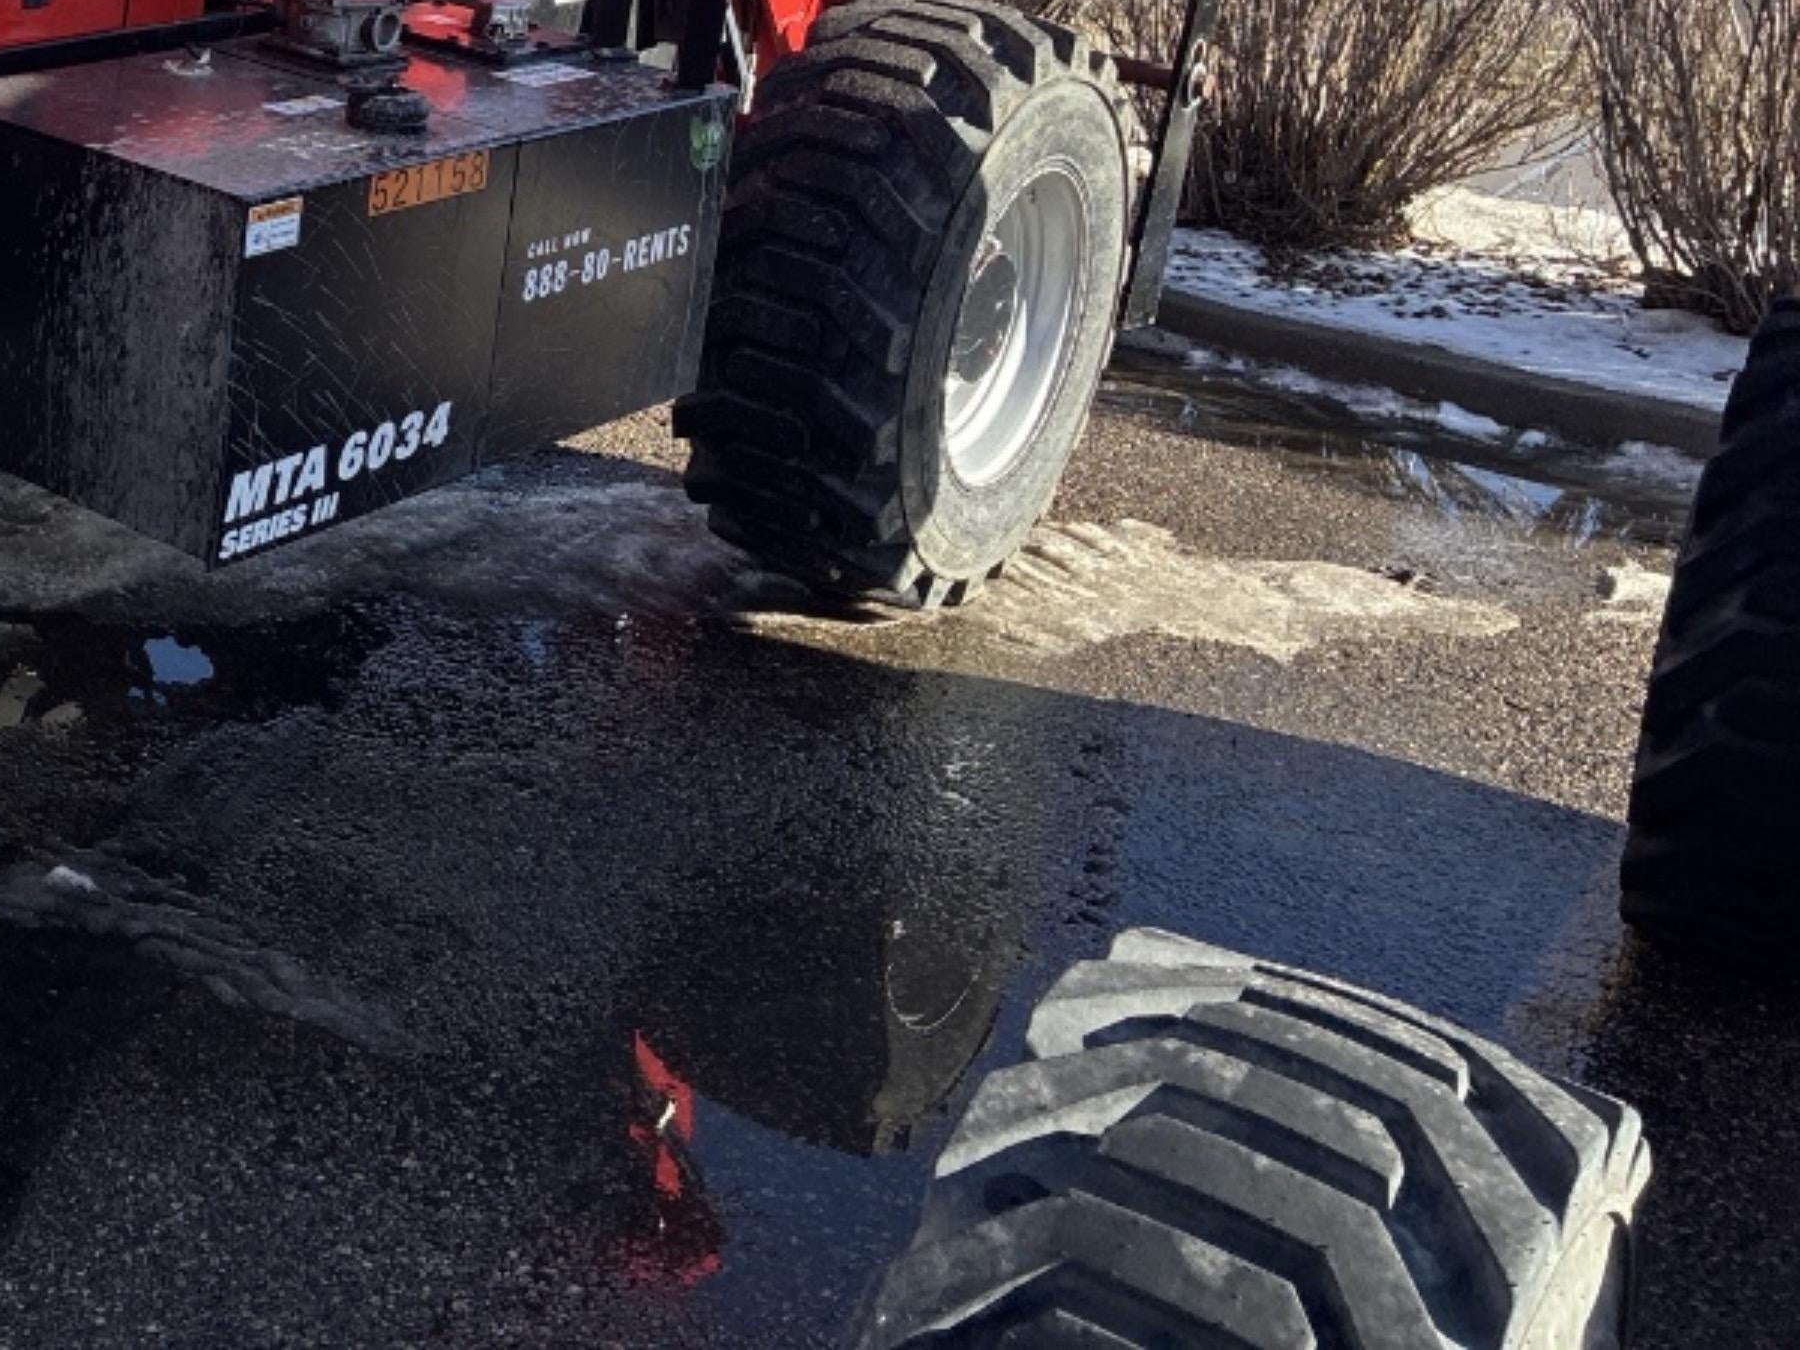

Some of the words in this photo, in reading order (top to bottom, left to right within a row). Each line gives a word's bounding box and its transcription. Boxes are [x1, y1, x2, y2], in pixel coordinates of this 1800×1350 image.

[522, 223, 693, 303] 888-80-RENTS
[527, 238, 559, 260] CALL
[563, 227, 593, 250] NOW
[223, 443, 329, 525] MTA
[337, 399, 453, 482] 6034
[217, 502, 311, 560] SERIES
